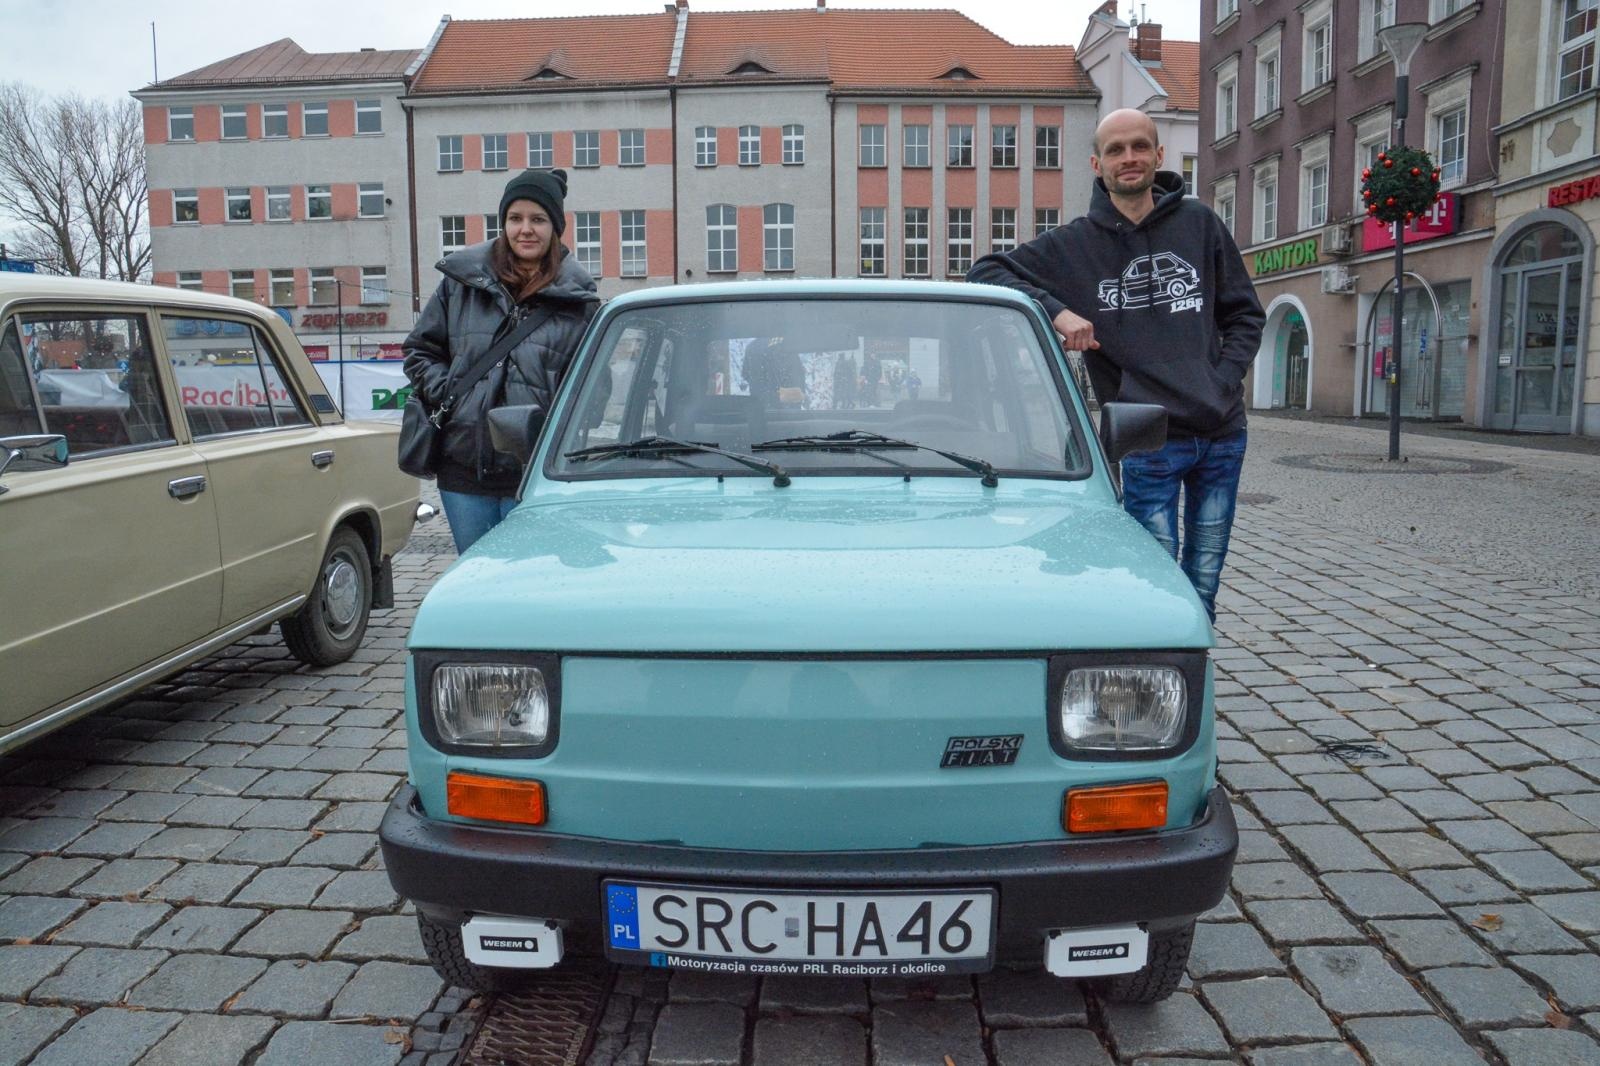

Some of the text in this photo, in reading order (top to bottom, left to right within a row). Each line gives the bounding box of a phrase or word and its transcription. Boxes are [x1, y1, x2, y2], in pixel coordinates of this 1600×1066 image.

[1255, 238, 1317, 273] KANTOR
[301, 311, 388, 330] zaprasza
[950, 736, 1022, 750] POLSKI
[947, 750, 1014, 765] FIAT
[613, 923, 636, 940] PL
[652, 894, 974, 957] SRC HA46
[483, 939, 523, 949] WESEM
[1072, 947, 1114, 958] WESEM
[667, 955, 746, 973] Motoryzacja
[750, 963, 799, 973] czasów
[803, 963, 828, 974] PRL
[832, 963, 889, 975] Raciborz
[892, 963, 897, 974] i
[900, 962, 947, 974] okolice
